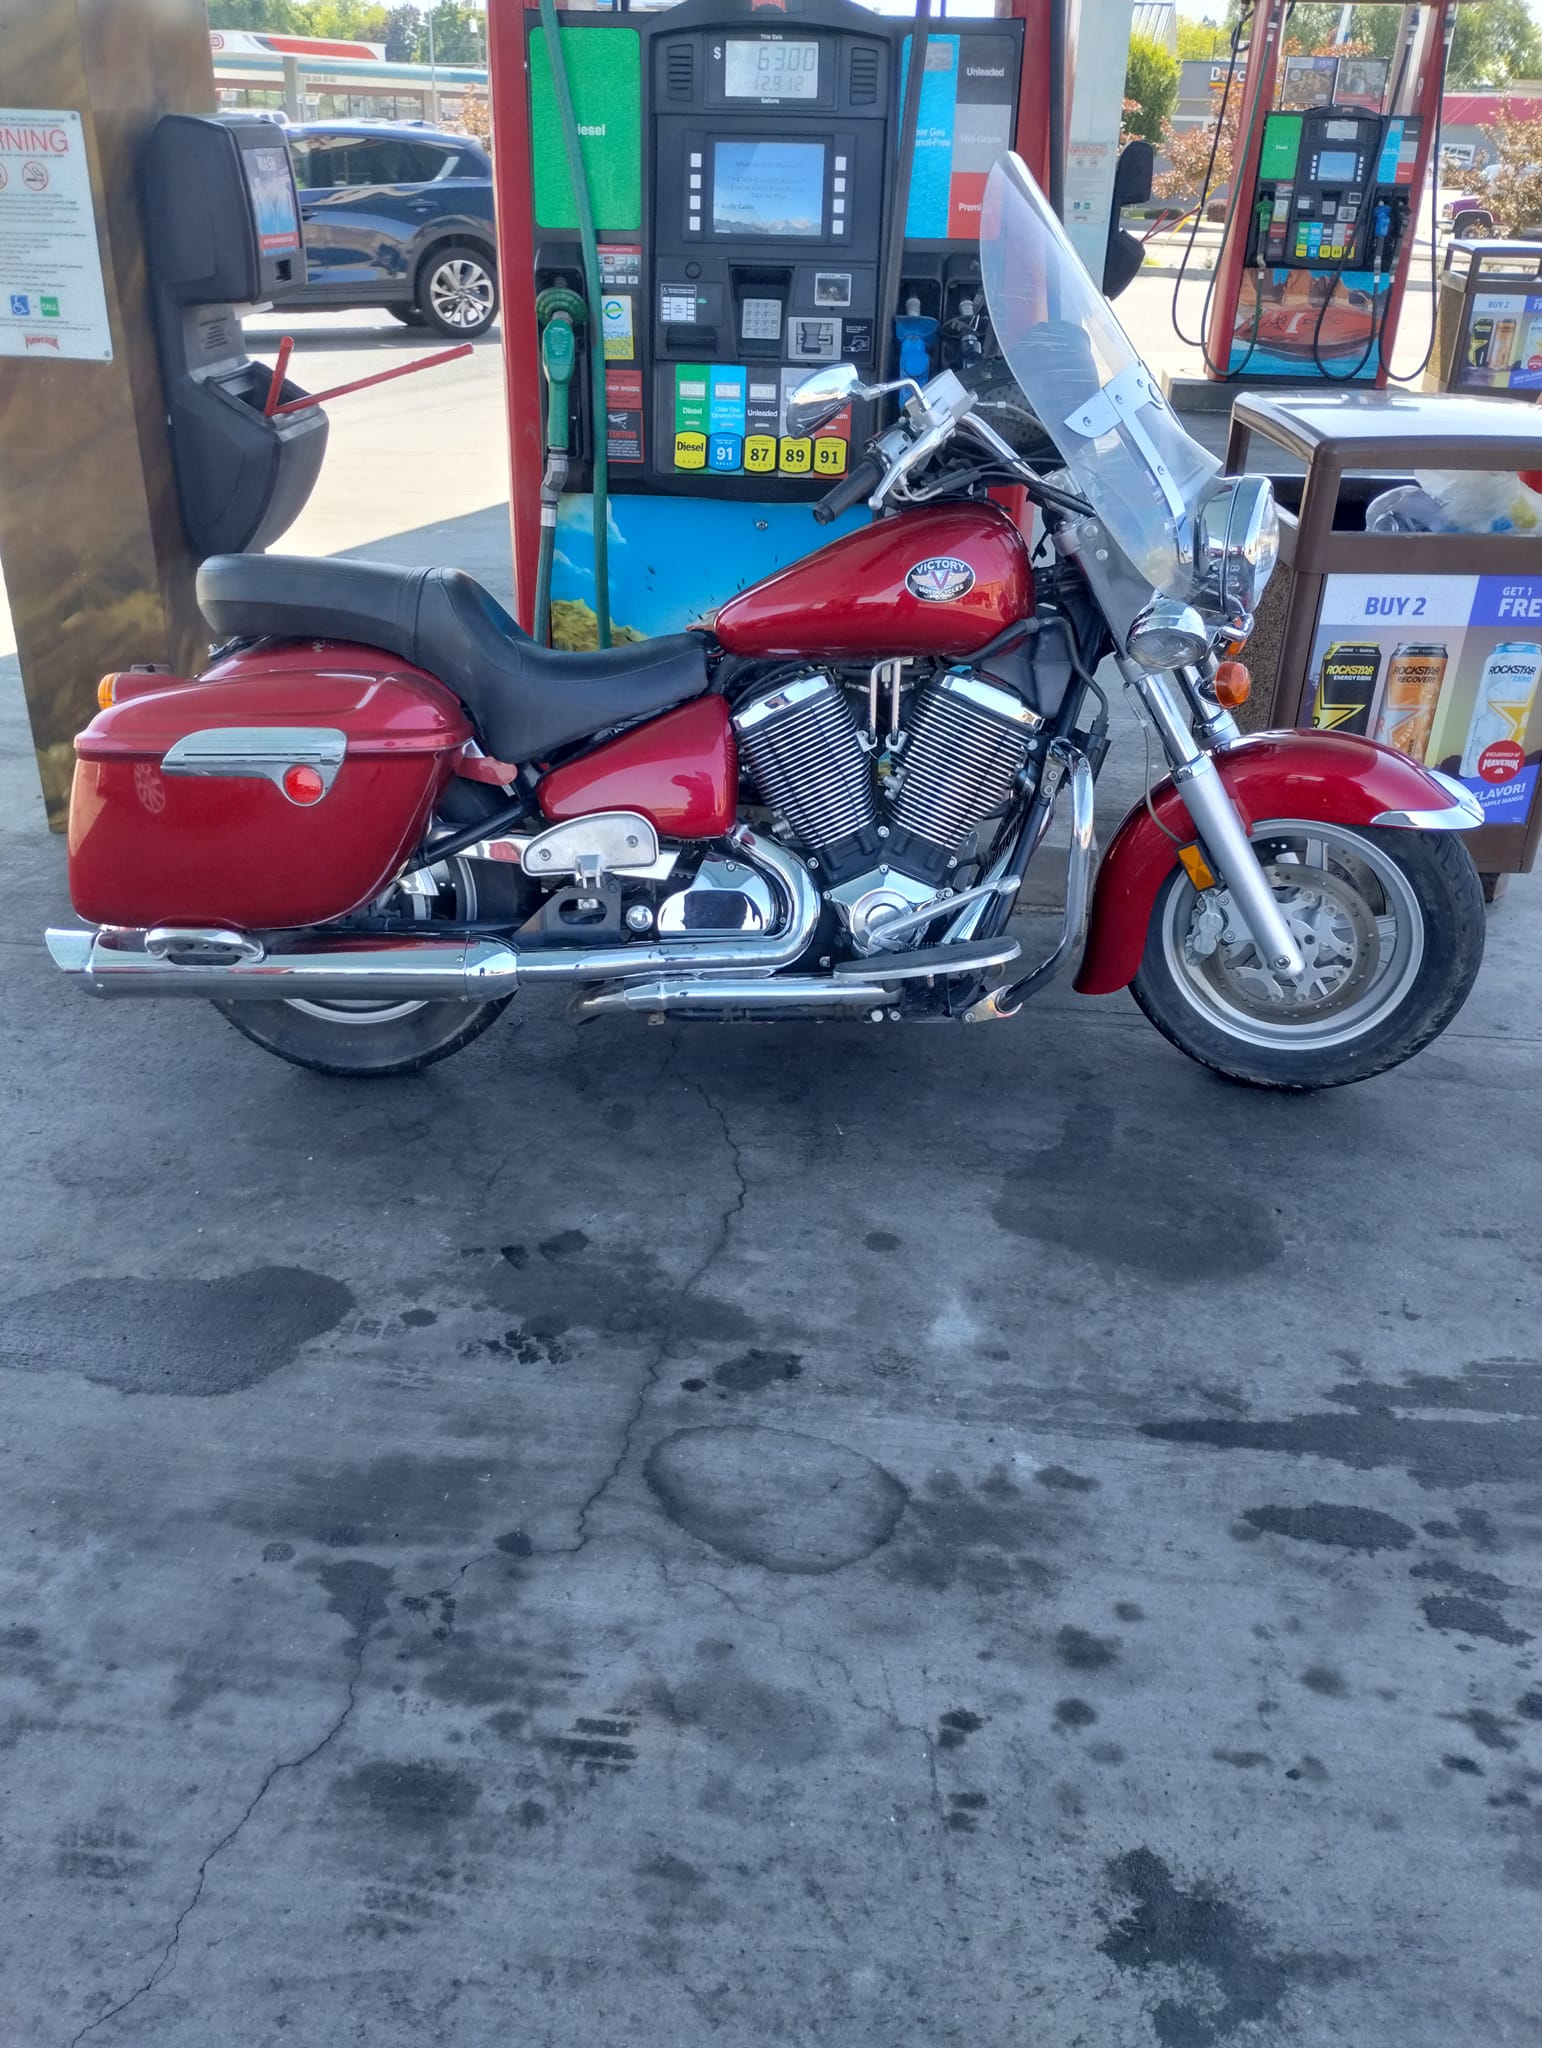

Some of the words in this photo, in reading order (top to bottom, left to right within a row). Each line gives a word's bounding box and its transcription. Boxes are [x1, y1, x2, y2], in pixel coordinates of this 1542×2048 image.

[713, 46, 721, 59] $
[966, 67, 1005, 77] Unleaded
[1417, 77, 1424, 96] 9
[577, 123, 606, 136] iesel
[0, 128, 69, 153] NING
[958, 202, 982, 212] Premi
[682, 407, 703, 415] Diesel
[747, 409, 778, 417] Unleaded
[677, 441, 704, 452] Diesel
[716, 446, 733, 461] 91
[750, 448, 769, 461] 87
[785, 449, 805, 462] 89
[820, 450, 838, 464] 91
[916, 560, 965, 574] VICTORY
[1503, 586, 1523, 596] GET
[1527, 587, 1533, 596] 1
[1365, 597, 1410, 616] BUY
[1412, 597, 1427, 616] 2
[1326, 665, 1375, 675] ROCKSTAR
[1393, 665, 1441, 675] ROCKSTAR
[1488, 665, 1537, 676] ROCKSTAR
[1482, 759, 1520, 771] MAVERIK
